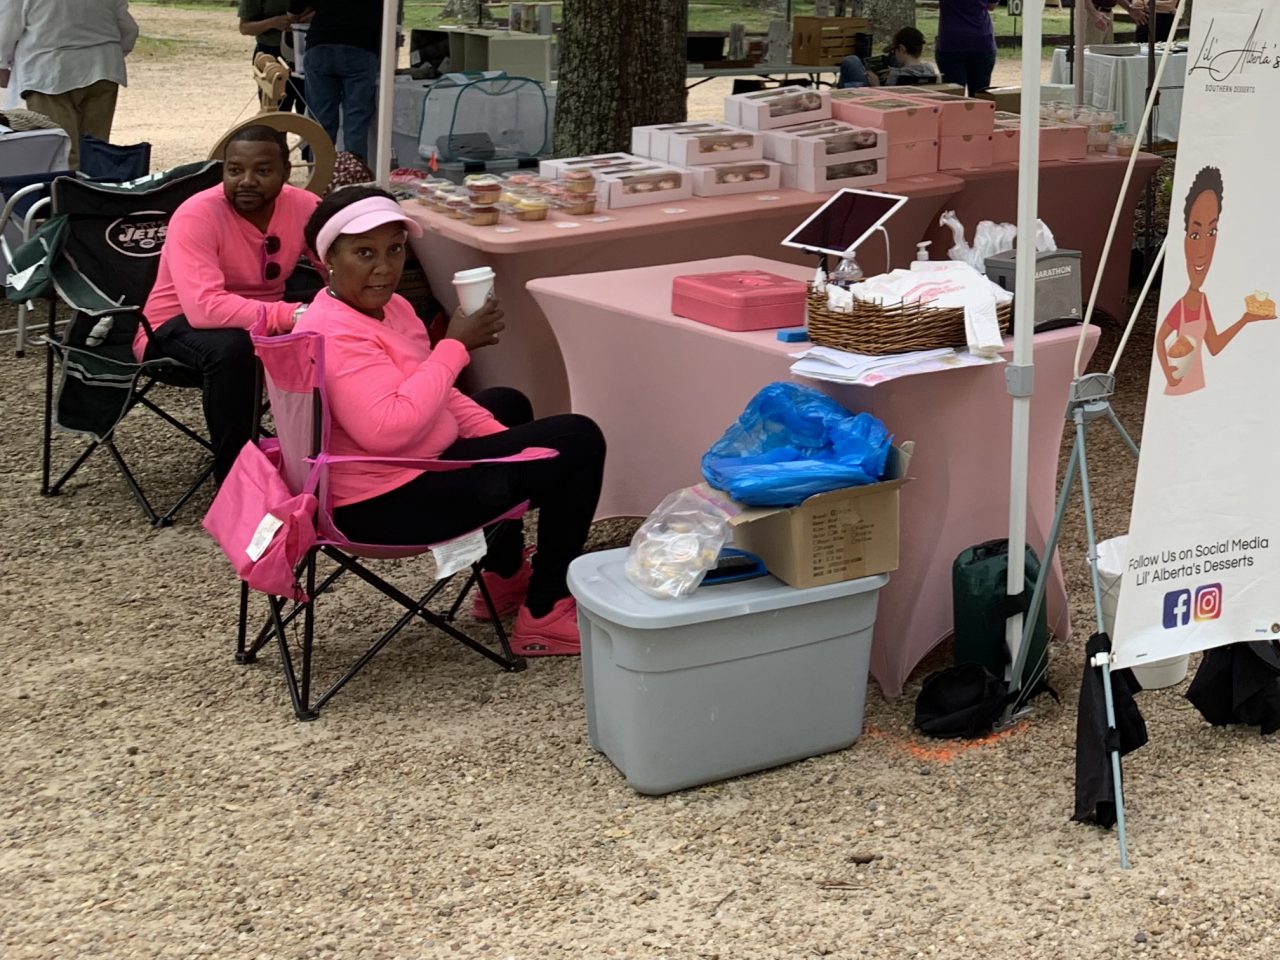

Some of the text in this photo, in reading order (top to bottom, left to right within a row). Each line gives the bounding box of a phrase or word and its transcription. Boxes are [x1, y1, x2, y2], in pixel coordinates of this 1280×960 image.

[1008, 0, 1021, 14] 10
[1205, 84, 1255, 94] SOUTHERN DESSERTS
[119, 226, 168, 241] JETS
[1128, 537, 1269, 572] Follow Us on Social Media
[1136, 555, 1254, 586] Lil' Alberta's Desserts
